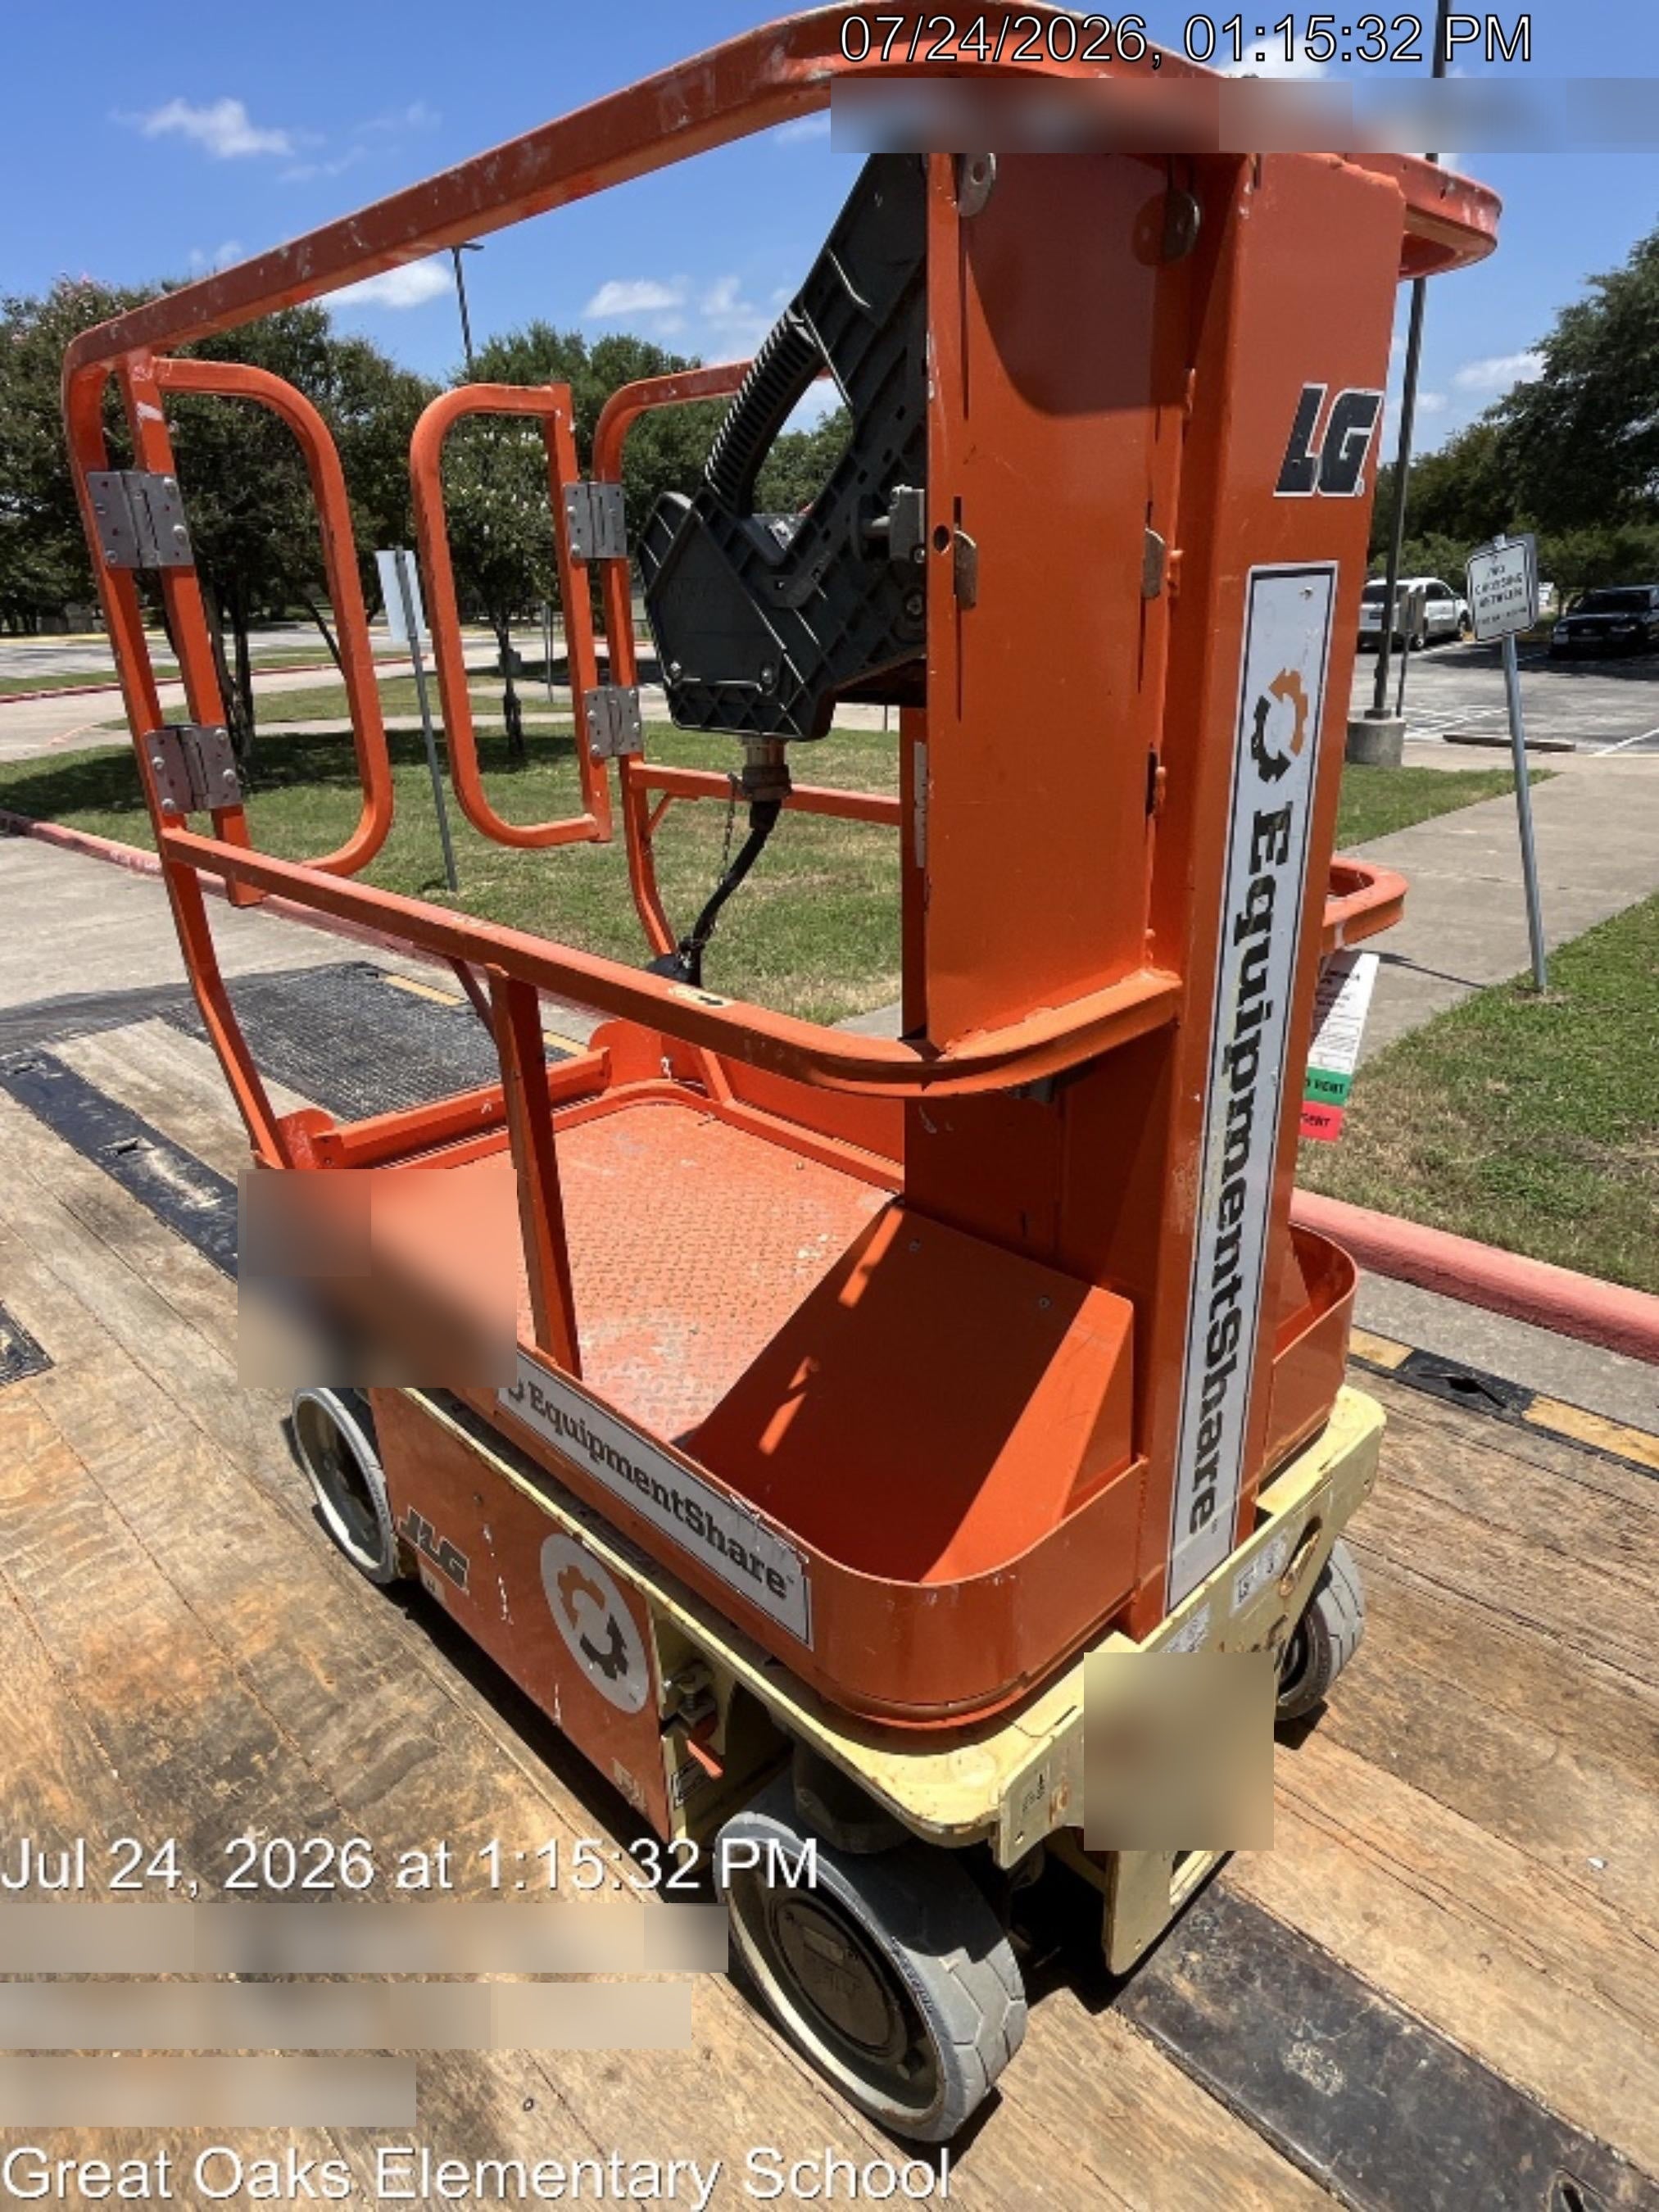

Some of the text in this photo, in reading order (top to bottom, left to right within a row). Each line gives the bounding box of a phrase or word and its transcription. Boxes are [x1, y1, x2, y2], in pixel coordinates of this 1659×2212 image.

[1189, 800, 1294, 1536] EquipmentShare
[397, 1504, 469, 1596] JLG
[528, 1380, 788, 1600] EquipmentShare
